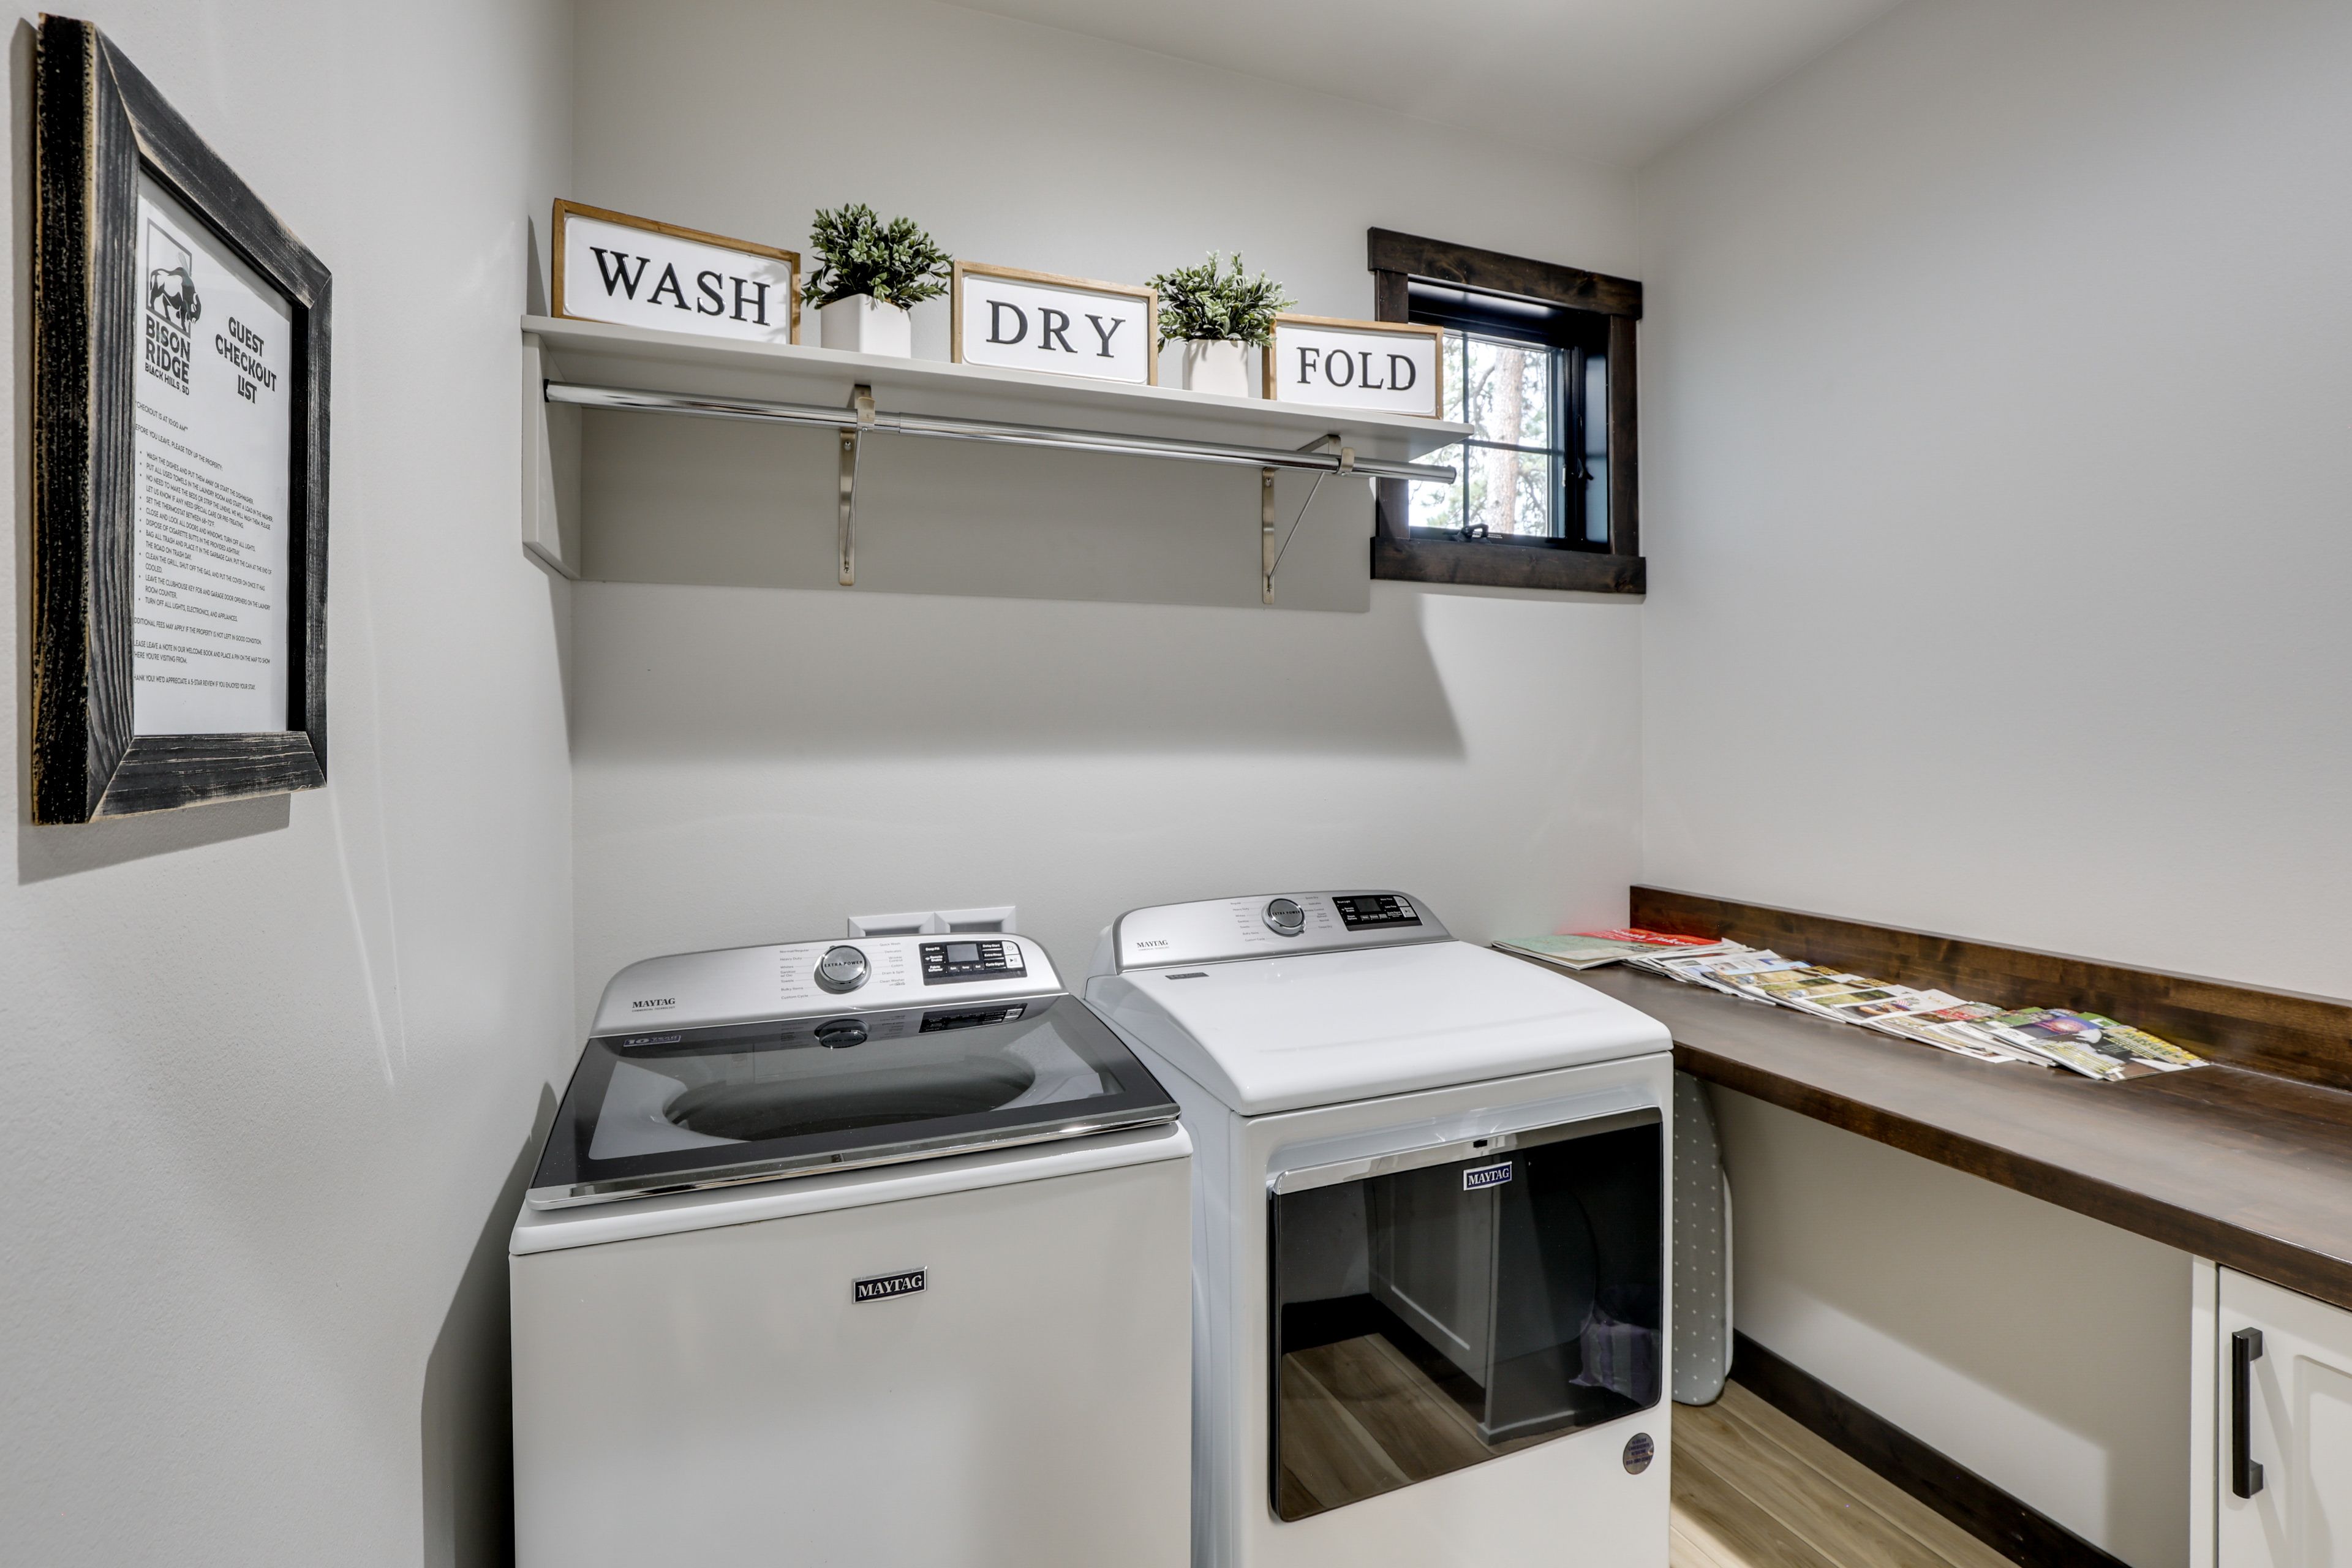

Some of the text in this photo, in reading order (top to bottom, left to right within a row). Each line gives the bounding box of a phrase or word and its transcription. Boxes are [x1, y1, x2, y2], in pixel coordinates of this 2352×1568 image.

[590, 246, 771, 326] WASH
[146, 314, 190, 363] BISON
[228, 317, 264, 357] GUEST
[986, 299, 1126, 358] DRY
[146, 337, 189, 385] RIDGE
[216, 334, 276, 392] CHECKOUT
[1297, 346, 1416, 391] FOLD
[145, 362, 163, 381] BLACK
[182, 385, 189, 396] SD
[238, 374, 257, 404] LIST
[168, 418, 178, 428] 10:00
[135, 423, 148, 435] EFORE
[149, 431, 157, 440] YOU
[172, 441, 184, 453] PLEASE
[146, 451, 157, 462] WASH
[166, 461, 179, 471] DISHES
[153, 477, 164, 486] NEED
[170, 484, 181, 494] MAKE
[189, 491, 197, 500] BEDS
[162, 469, 172, 479] USED
[173, 474, 187, 486] TOWELS
[159, 490, 172, 500] KNOW
[184, 500, 194, 508] NEED
[146, 508, 159, 518] CLOSE
[168, 515, 178, 525] LOCK
[186, 522, 198, 532] DOORS
[186, 511, 201, 522] BETWEEN
[146, 518, 162, 530] DISPOSE
[188, 533, 198, 542] BUTTS
[146, 529, 154, 538] BAG
[162, 535, 175, 544] TRASH
[184, 542, 195, 551] PLACE
[145, 552, 159, 561] CLEAN
[154, 543, 165, 552] ROAD
[172, 549, 184, 558] TRASH
[145, 575, 157, 583] LEAVE
[145, 586, 158, 594] ROOM
[134, 617, 156, 627] DDITIONAL
[632, 998, 676, 1008] MAYTAG
[1468, 1168, 1509, 1185] MAYTAG
[858, 1275, 922, 1298] MAYTAG
